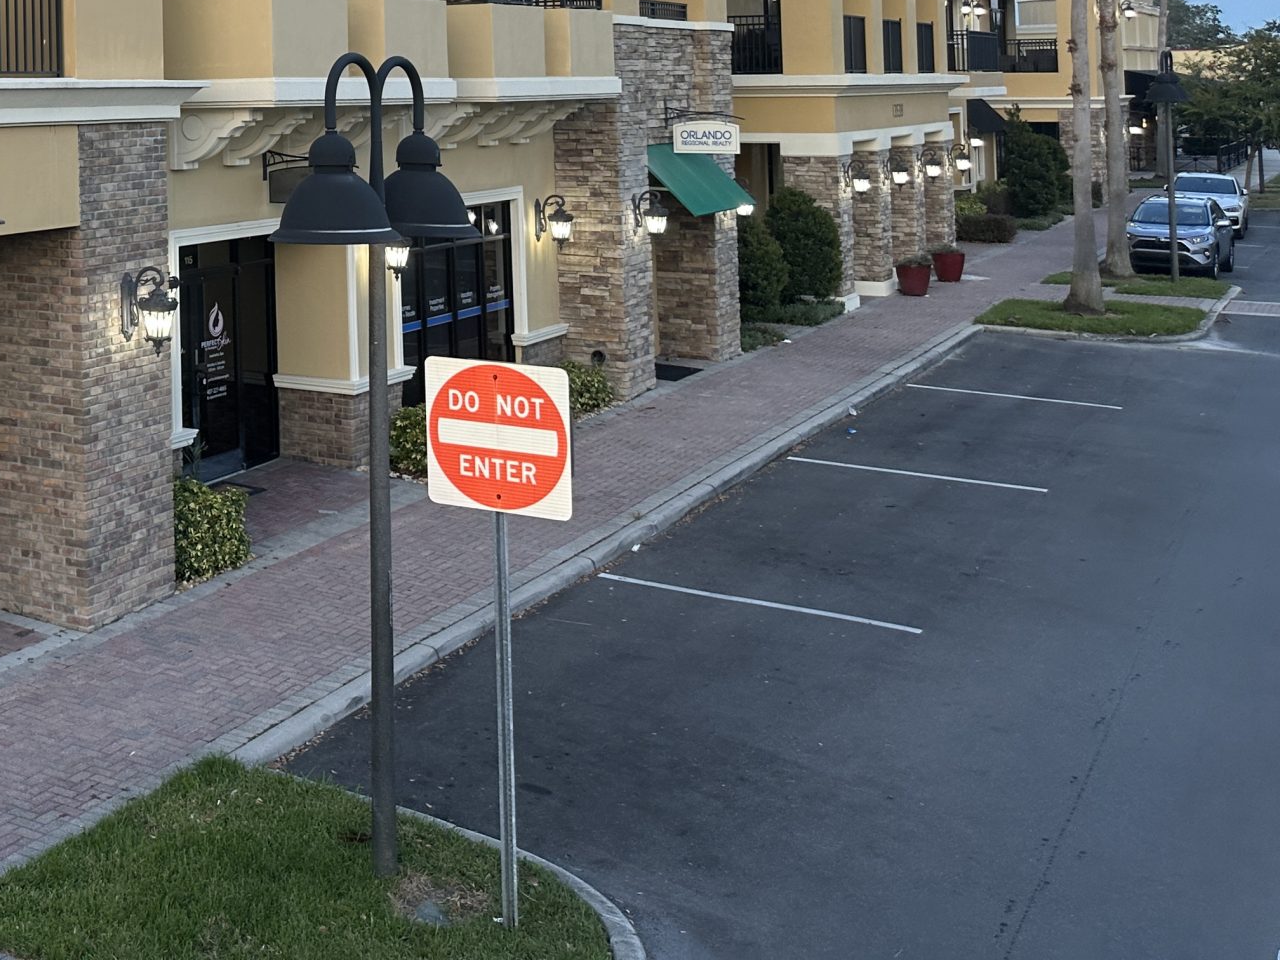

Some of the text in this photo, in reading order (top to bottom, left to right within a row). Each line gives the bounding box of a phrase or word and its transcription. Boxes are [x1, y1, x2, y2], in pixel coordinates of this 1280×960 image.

[680, 130, 732, 140] ORLANDO
[184, 255, 194, 265] 115
[448, 388, 544, 420] DO NOT
[459, 454, 537, 486] ENTER
